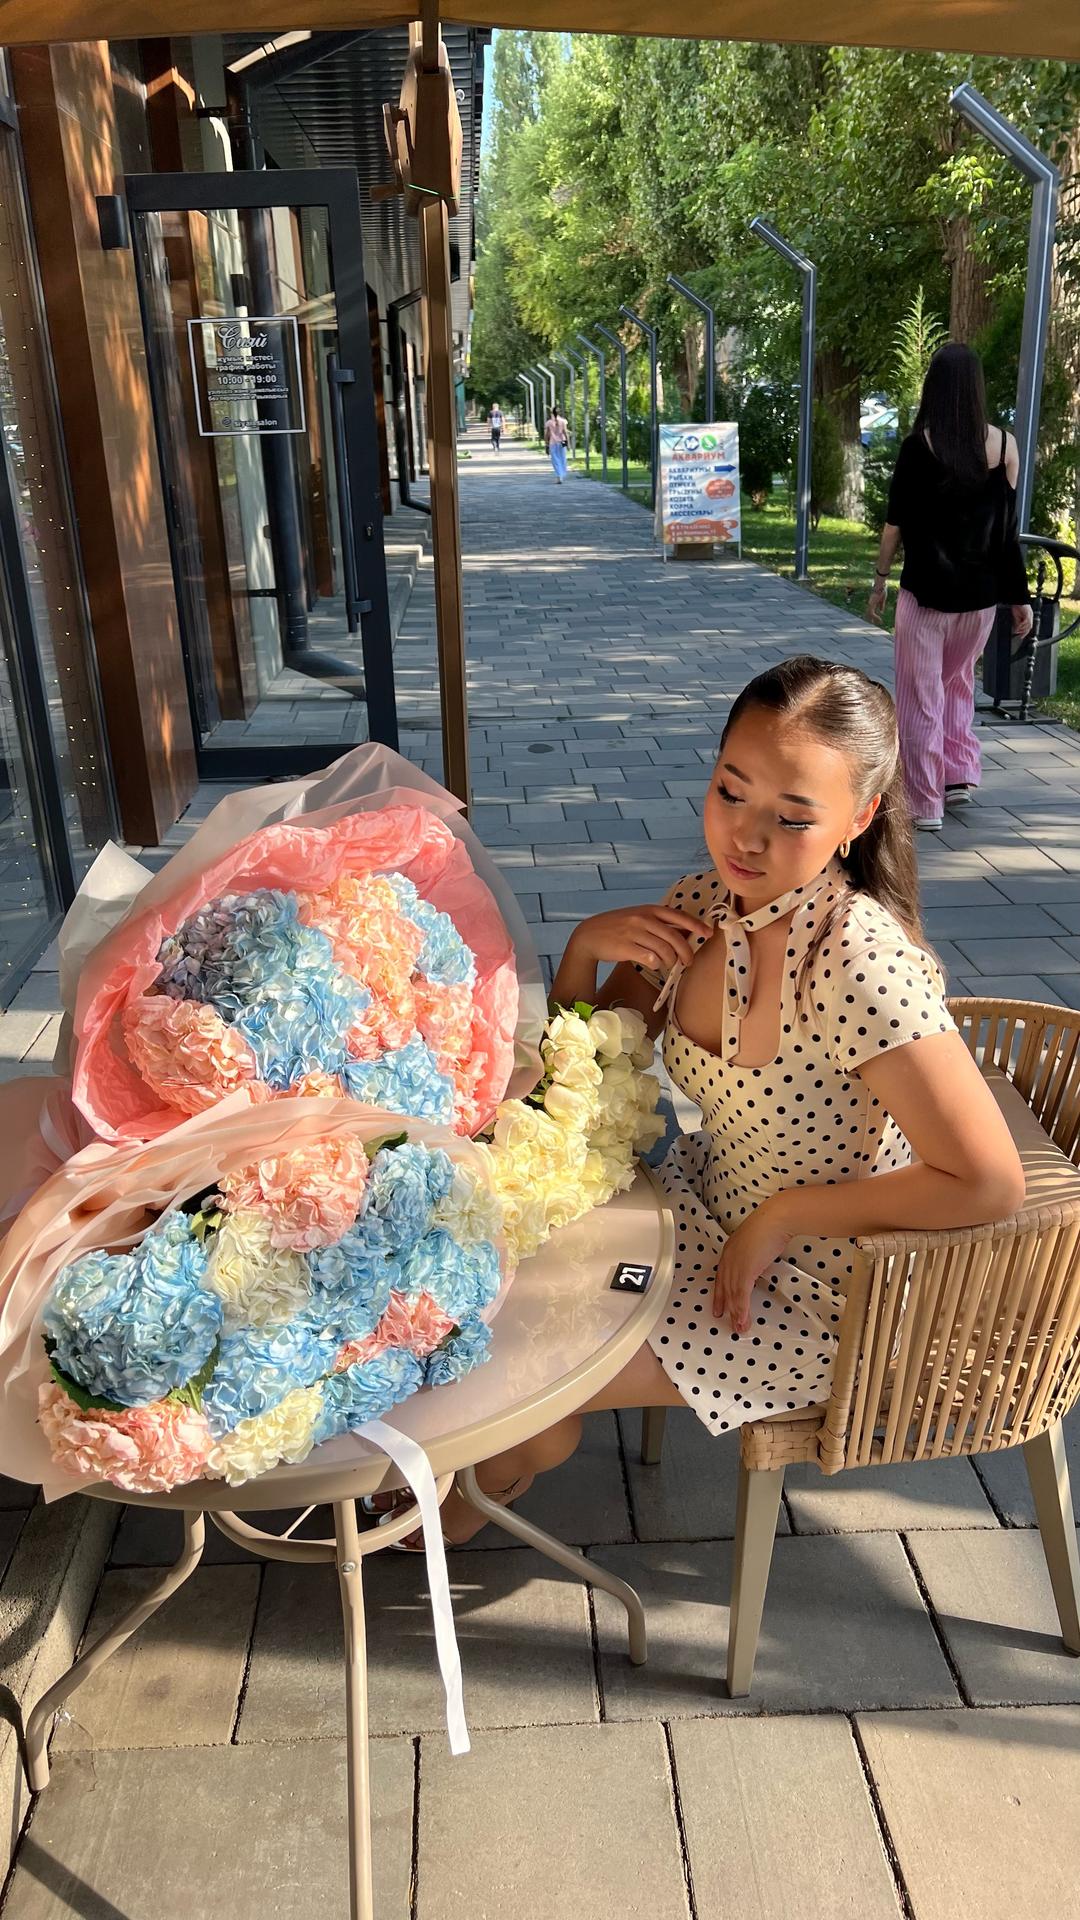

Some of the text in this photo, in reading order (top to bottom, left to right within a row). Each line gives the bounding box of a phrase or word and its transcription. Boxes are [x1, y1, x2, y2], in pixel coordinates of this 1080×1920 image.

[217, 325, 268, 349] Сияй
[215, 362, 277, 372] график работы
[217, 375, 243, 385] 10:00
[251, 374, 277, 384] 19:00
[672, 452, 725, 462] АКВАРИУМ
[619, 1267, 647, 1286] 21
